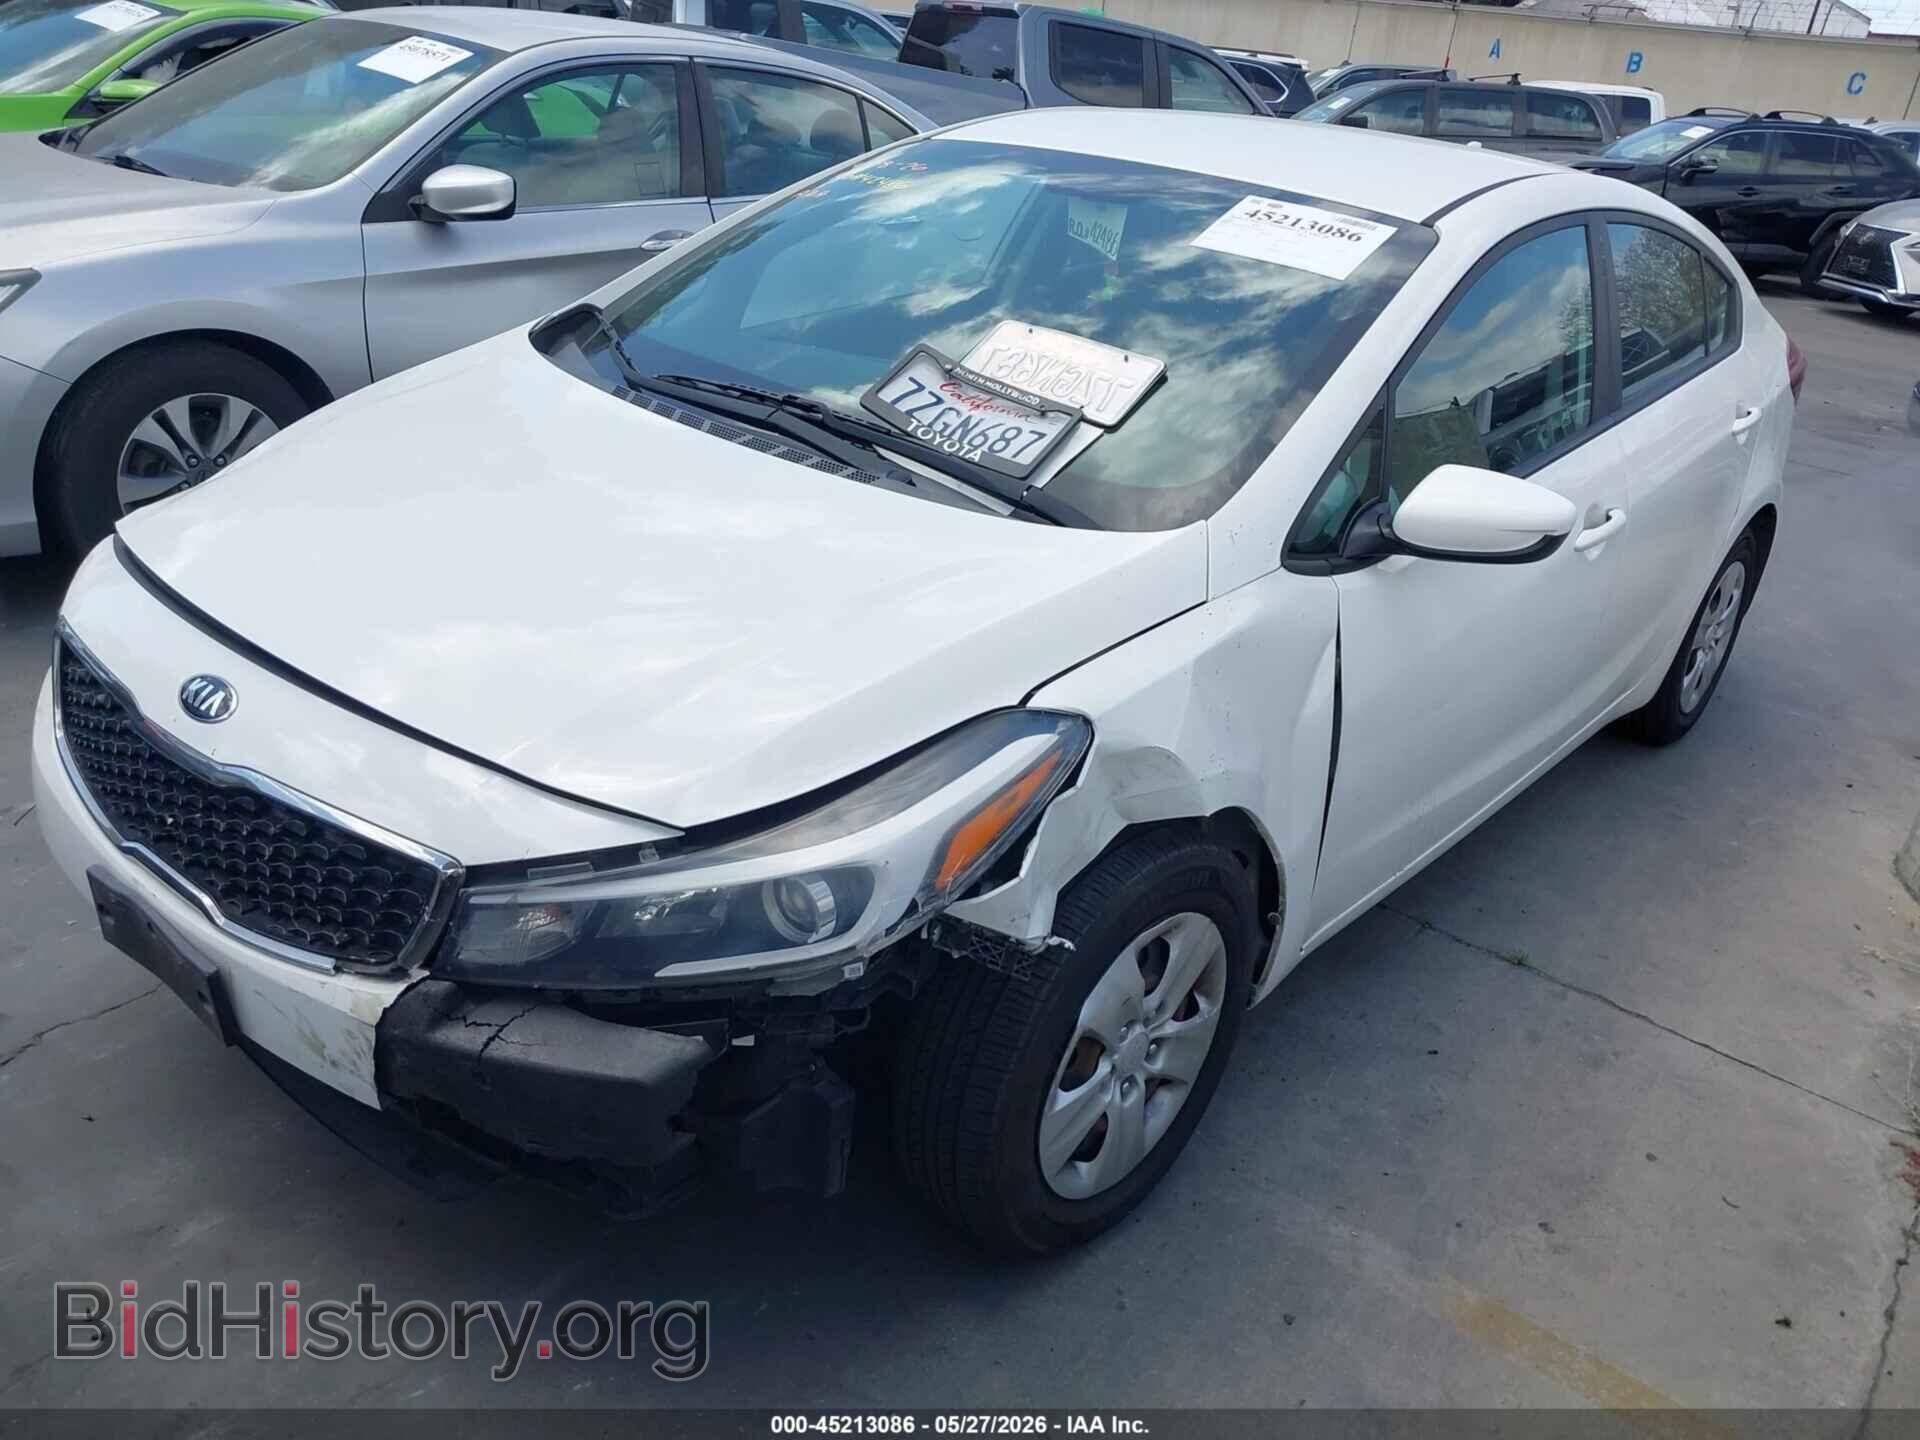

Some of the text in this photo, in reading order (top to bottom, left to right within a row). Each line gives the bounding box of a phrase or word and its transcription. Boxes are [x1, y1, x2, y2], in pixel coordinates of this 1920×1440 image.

[1487, 37, 1501, 60] A
[1625, 51, 1644, 74] B
[1846, 71, 1867, 96] C
[1243, 207, 1364, 243] 45213086
[889, 375, 1047, 459] 7ZGN687
[938, 382, 1038, 424] California
[906, 418, 984, 463] TOYOTA
[181, 678, 226, 717] KIA
